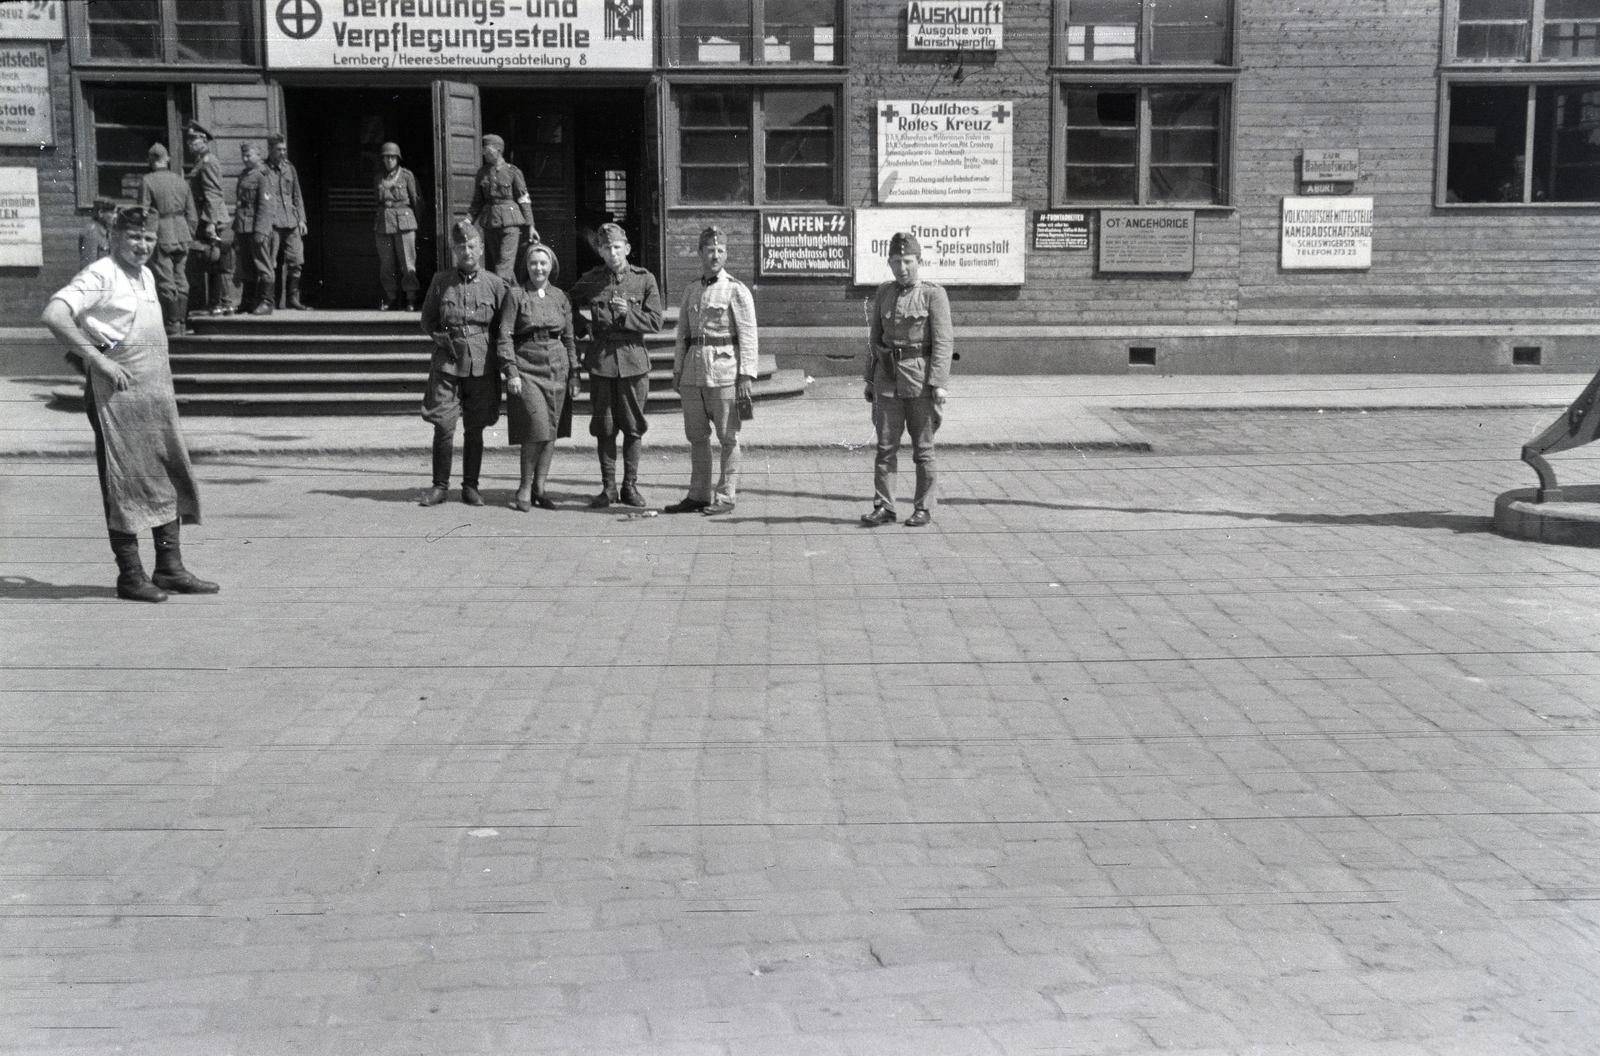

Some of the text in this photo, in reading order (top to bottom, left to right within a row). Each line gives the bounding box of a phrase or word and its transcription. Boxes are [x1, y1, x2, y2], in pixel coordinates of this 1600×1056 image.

[909, 2, 1001, 25] Auskunft
[332, 21, 590, 53] Verpflegungsstelle
[918, 24, 992, 37] Ausgabe von
[0, 51, 45, 68] itstelle
[579, 54, 587, 65] 8
[898, 116, 992, 131] Rotes Kreuz
[1283, 209, 1373, 224] VOLKSDEUTSCHE MITTELSTELLE
[910, 225, 971, 238] Standort
[1284, 225, 1373, 237] KAMERADSCHAFTSHAUS
[768, 247, 844, 260] Siegfriedstrasse 100
[936, 240, 1010, 256] Speiseanstalt
[1297, 248, 1333, 256] TELEFON
